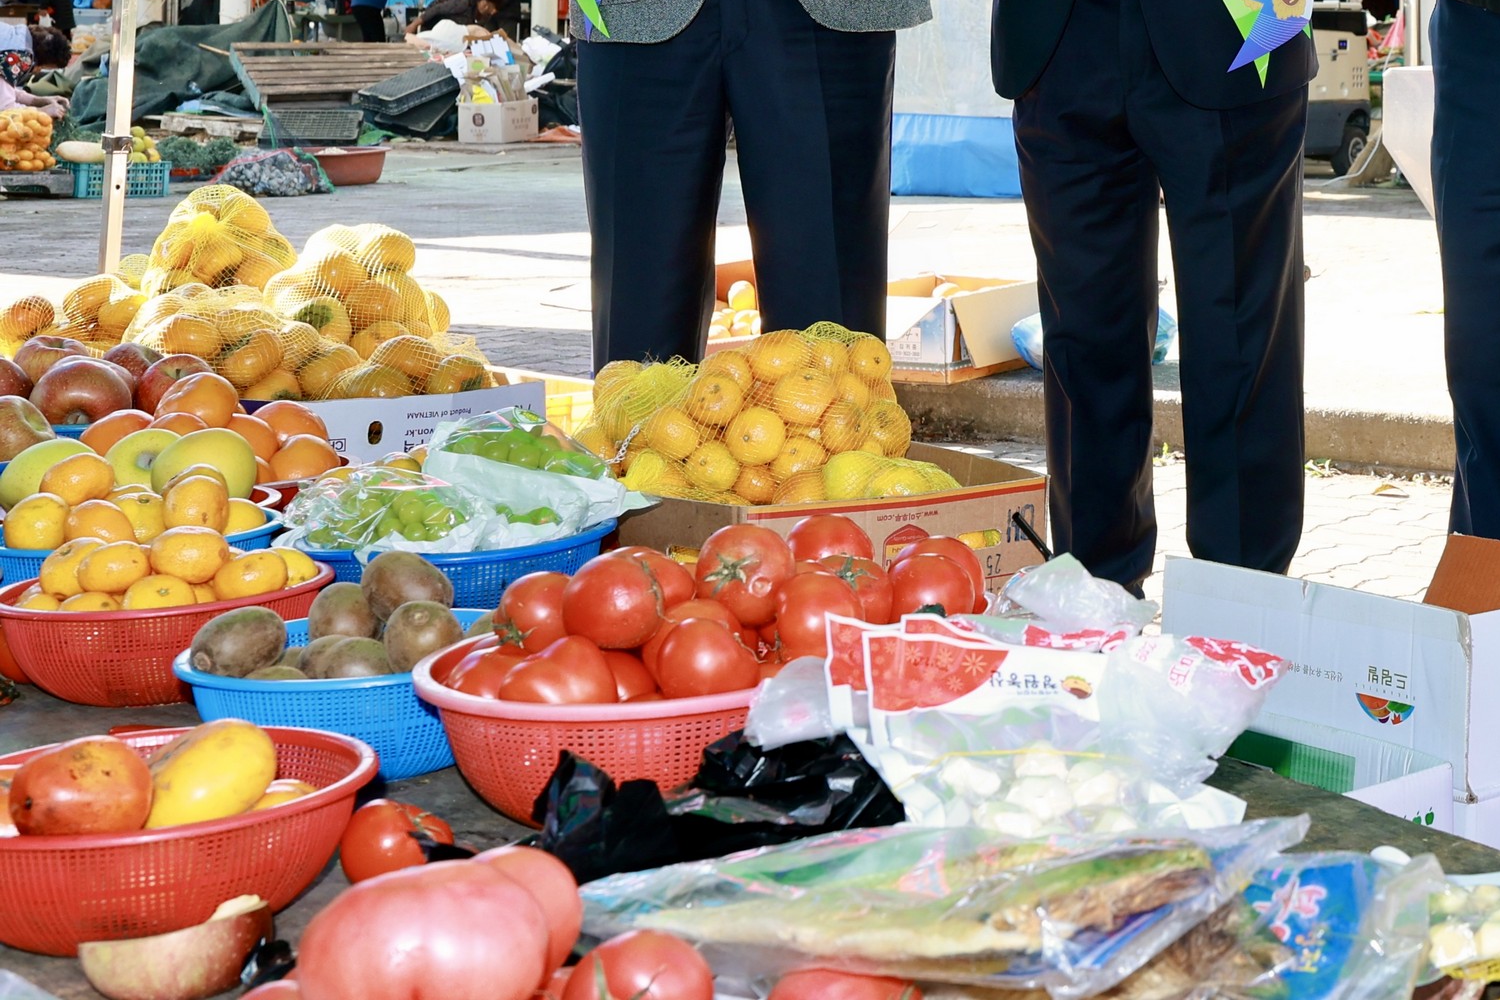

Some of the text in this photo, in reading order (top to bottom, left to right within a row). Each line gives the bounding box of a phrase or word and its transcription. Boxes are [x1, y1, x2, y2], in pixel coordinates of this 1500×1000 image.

[407, 410, 439, 420] VIETNAM
[450, 407, 472, 416] Product
[1324, 670, 1343, 682] 신선도
[1367, 665, 1408, 690] 드림빌
